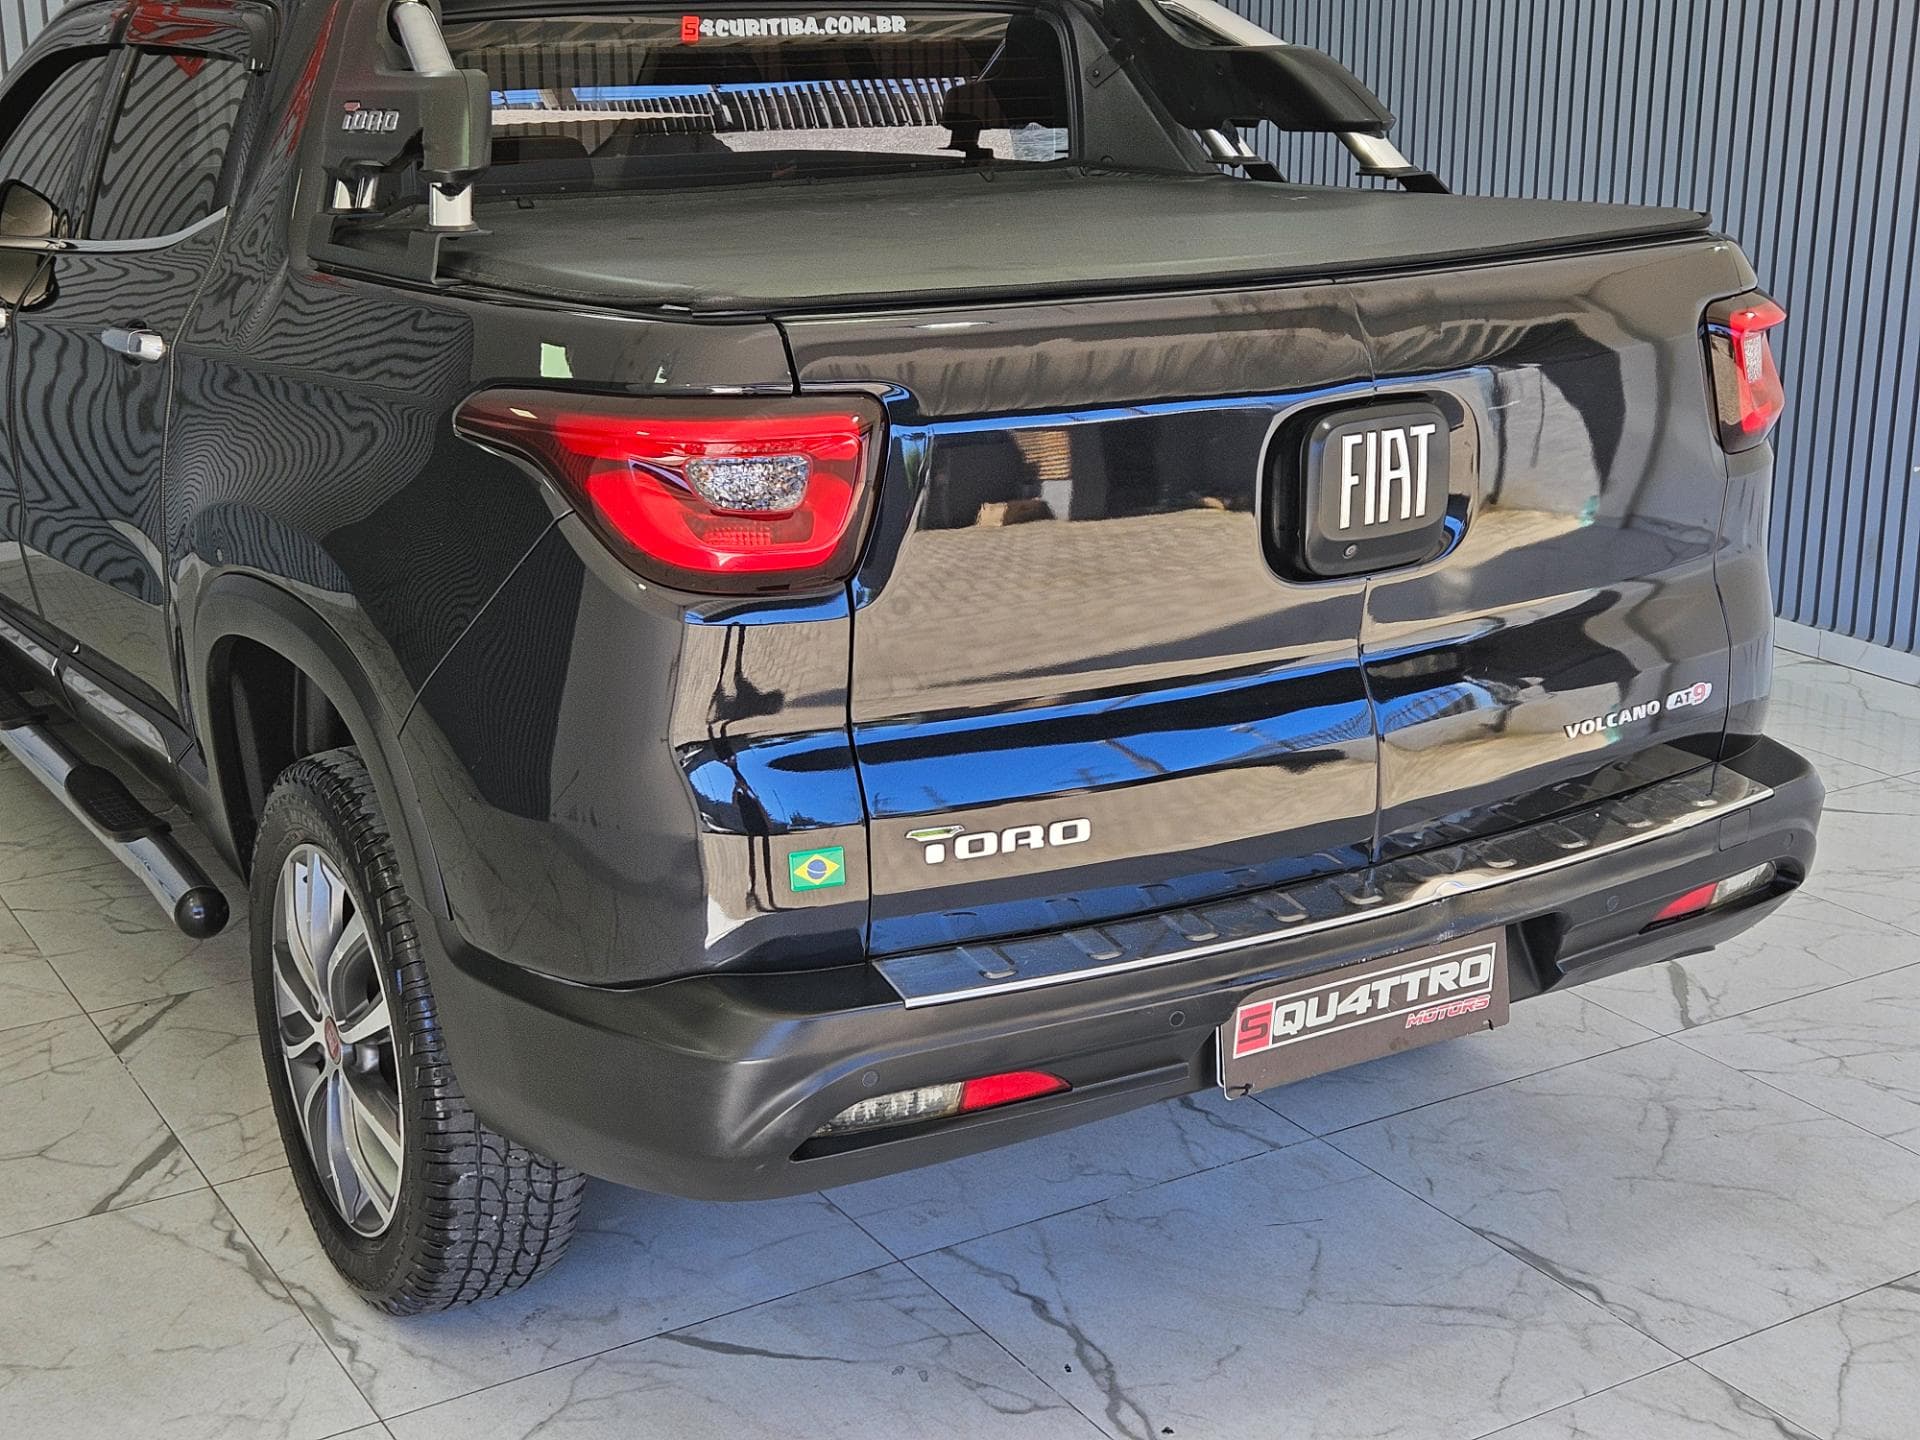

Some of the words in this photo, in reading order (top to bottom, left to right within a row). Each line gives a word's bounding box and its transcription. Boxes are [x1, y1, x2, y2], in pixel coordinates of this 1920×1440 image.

[1339, 423, 1436, 530] FIAT
[1565, 700, 1661, 739] VOLCANO
[1671, 682, 1709, 708] AT9
[905, 818, 1092, 865] TORO
[1405, 995, 1491, 1029] MOTORS
